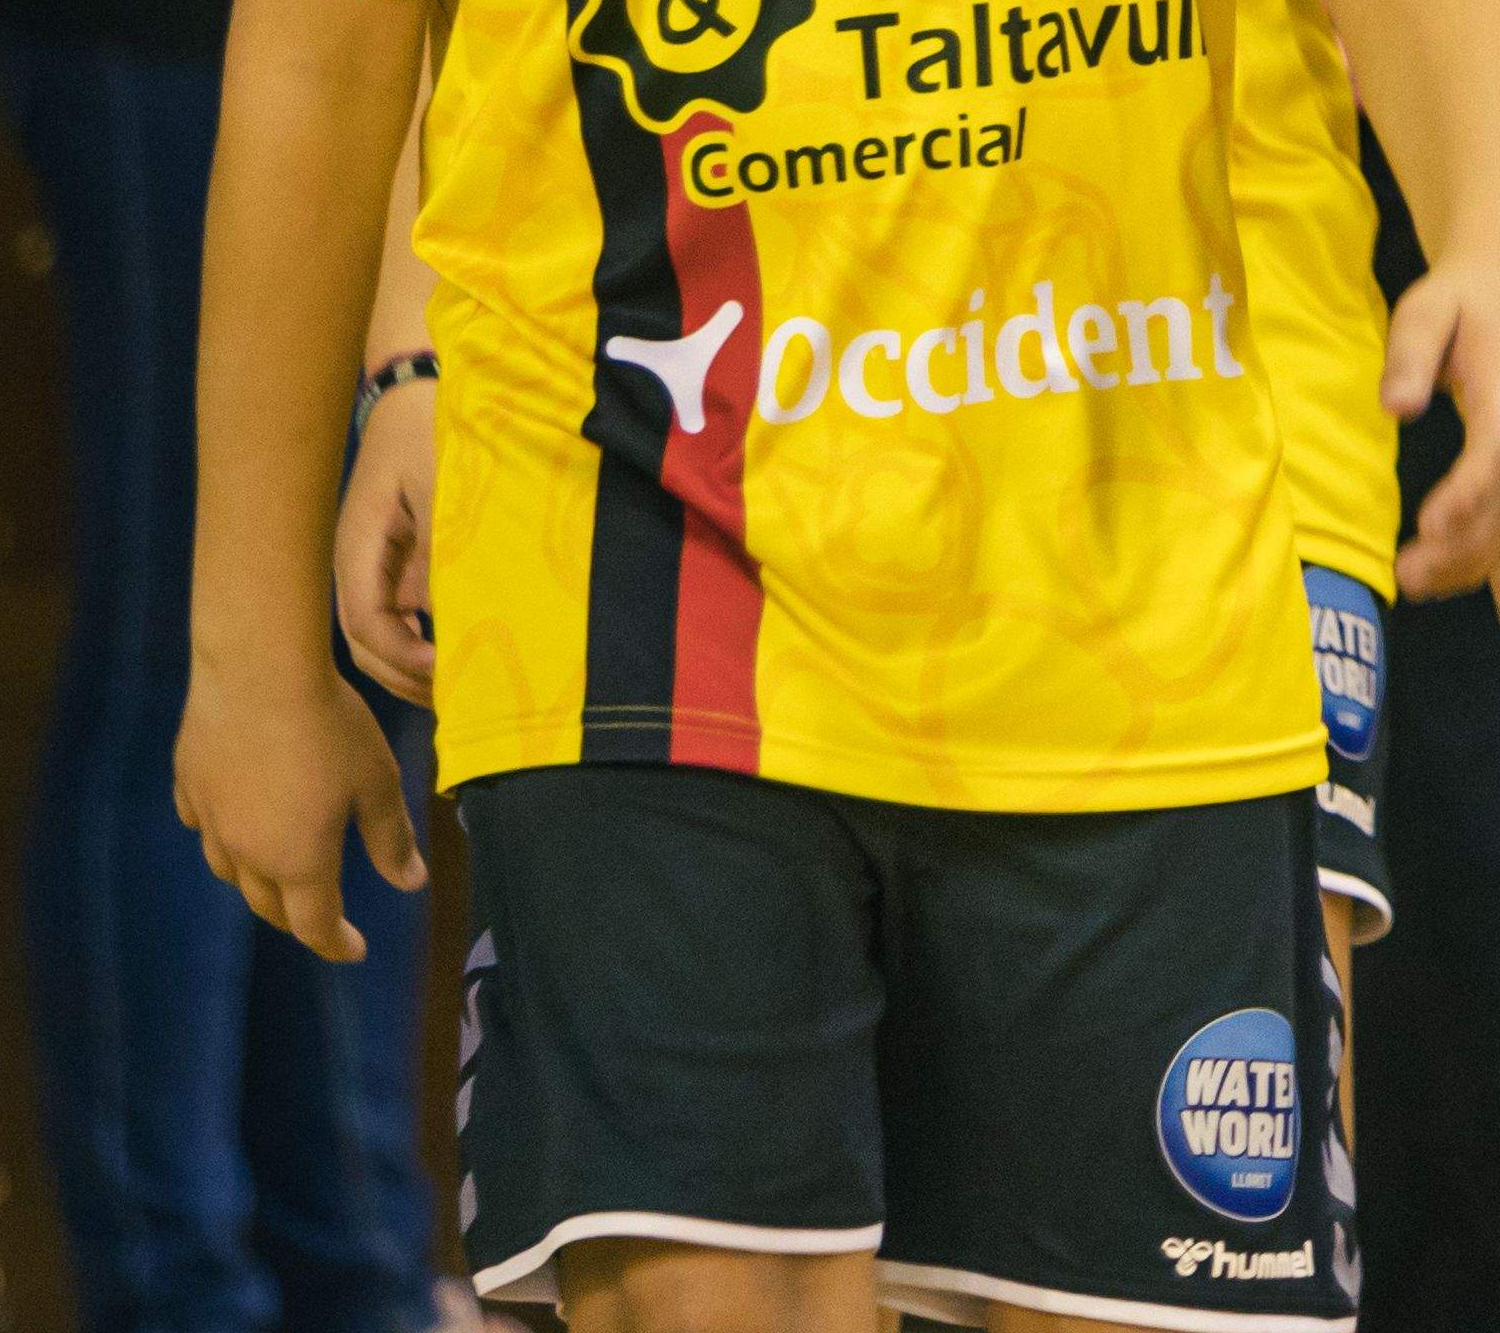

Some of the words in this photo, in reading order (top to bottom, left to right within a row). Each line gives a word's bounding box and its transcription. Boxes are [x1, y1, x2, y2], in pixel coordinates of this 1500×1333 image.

[690, 108, 1028, 199] Comercial
[756, 274, 1246, 424] Occident
[1186, 1058, 1296, 1109] WATE
[1180, 1109, 1294, 1159] WORL
[1211, 1239, 1315, 1279] hummel
